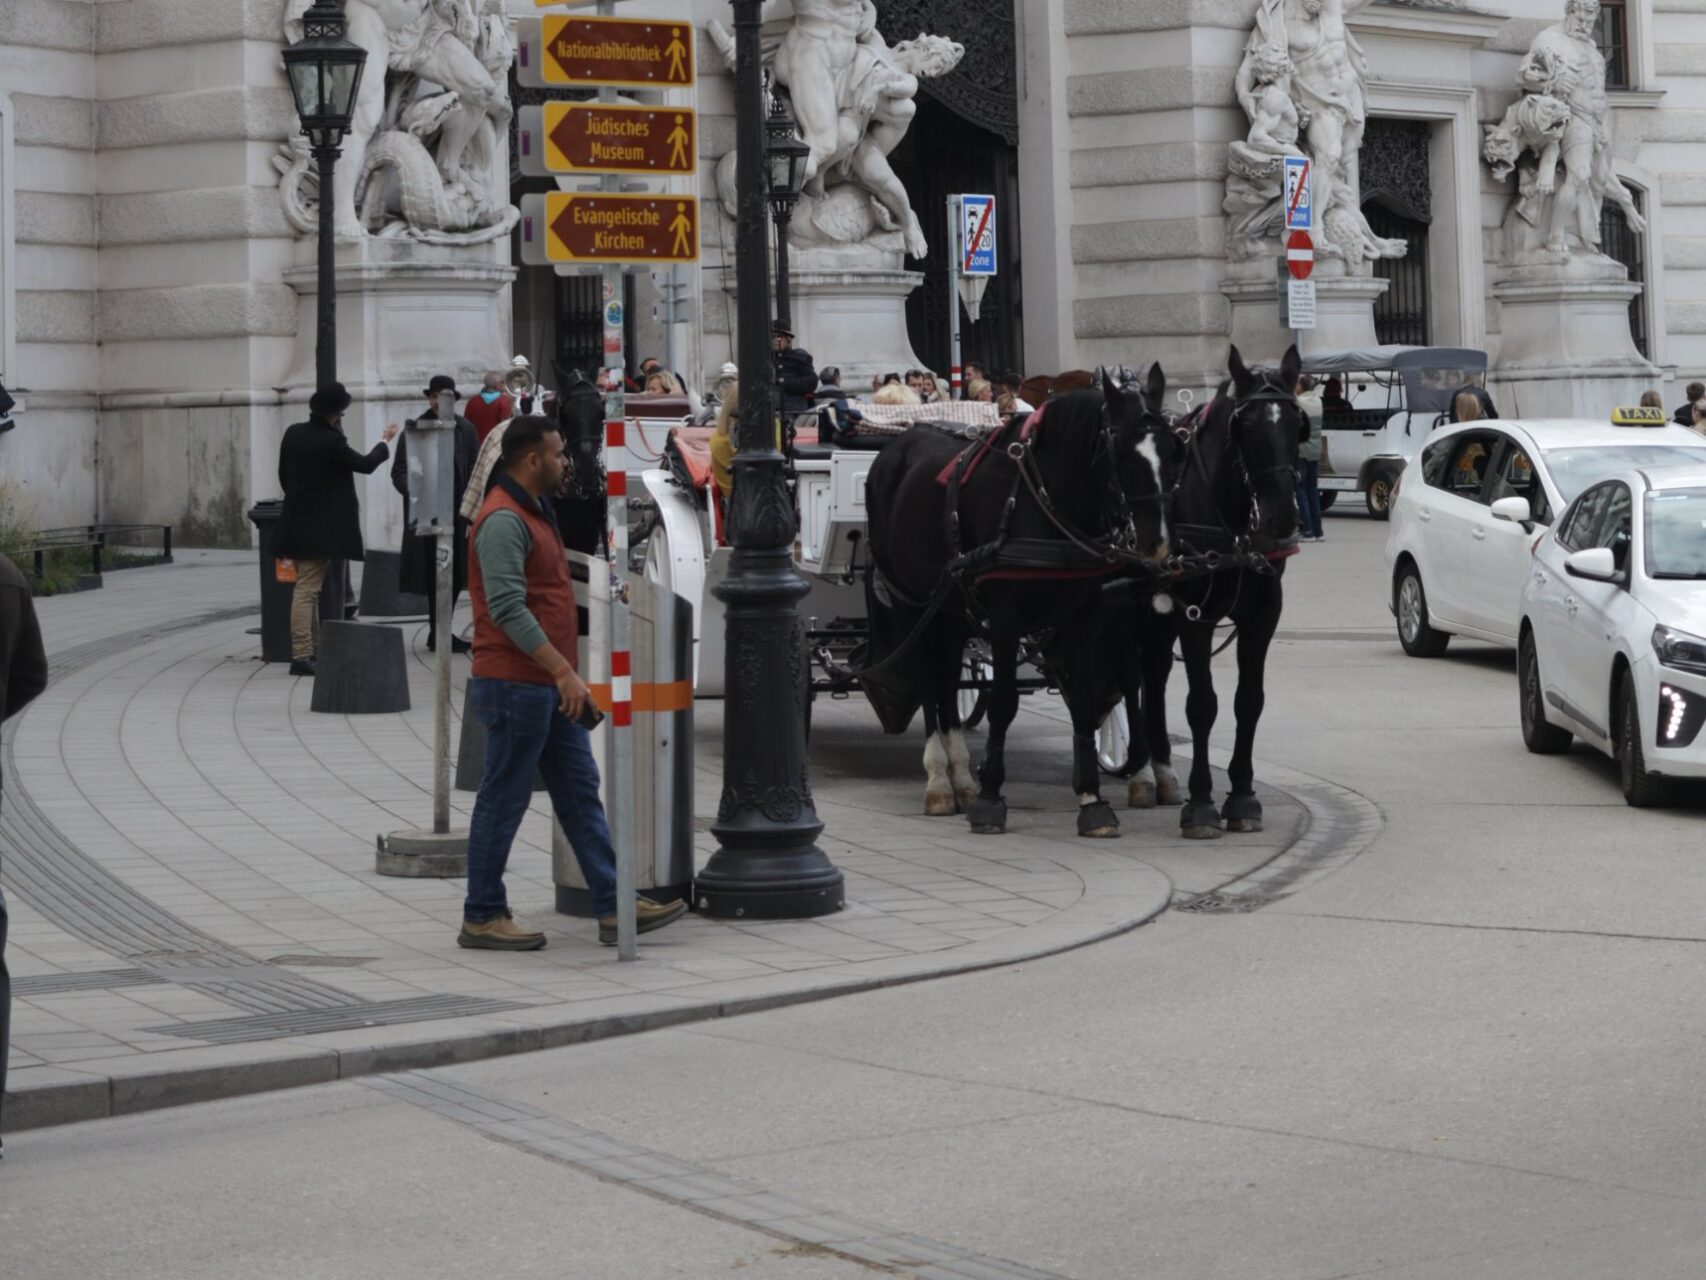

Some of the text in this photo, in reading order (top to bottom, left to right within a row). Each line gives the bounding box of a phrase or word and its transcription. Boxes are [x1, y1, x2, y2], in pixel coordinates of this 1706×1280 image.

[557, 40, 662, 63] Nationalbibliothek
[585, 117, 650, 138] Jüdisches
[590, 142, 645, 161] Museum
[573, 206, 661, 229] Evangelische
[594, 231, 645, 250] Kirchen
[981, 234, 991, 247] 20
[970, 254, 989, 266] Zone
[1623, 408, 1660, 419] TAXI
